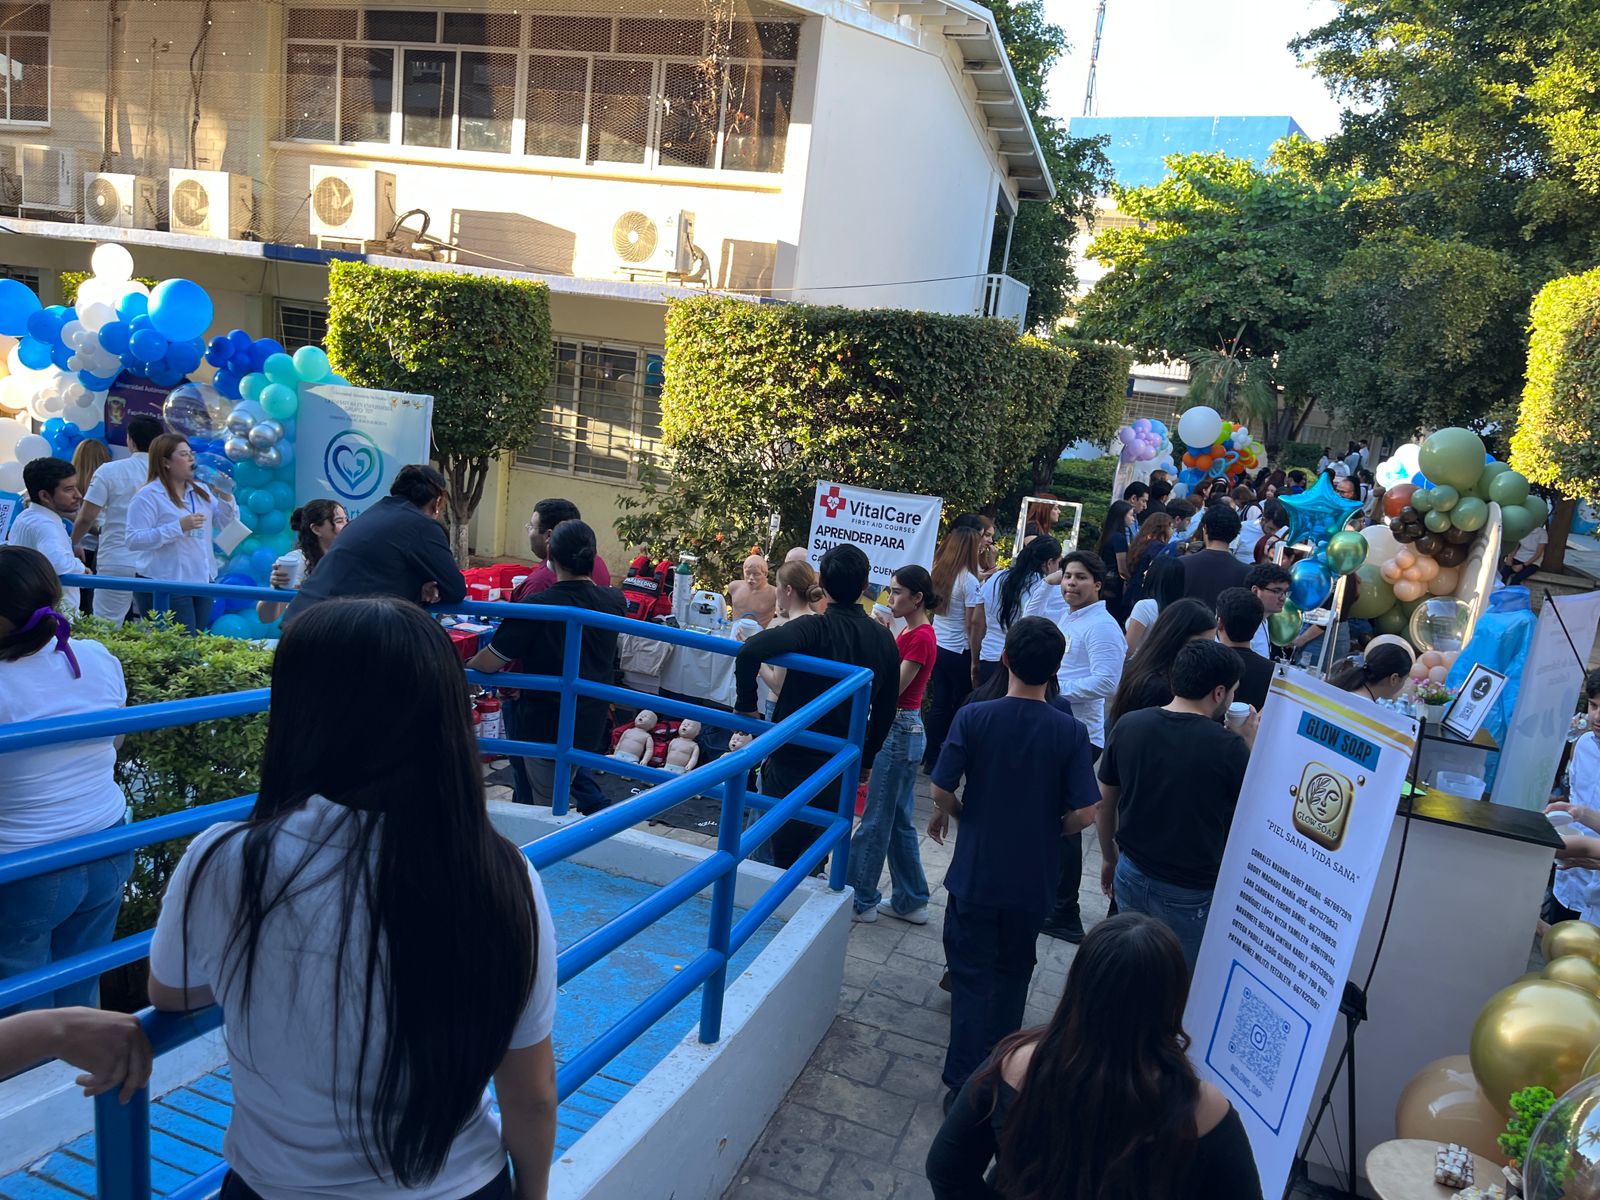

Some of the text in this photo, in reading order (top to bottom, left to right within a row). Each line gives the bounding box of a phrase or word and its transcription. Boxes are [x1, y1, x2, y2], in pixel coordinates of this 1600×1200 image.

[850, 500, 922, 526] VitalCare
[851, 518, 870, 527] FIRST
[885, 524, 916, 534] COURSES
[816, 524, 905, 550] APRENDER PARA
[1305, 717, 1373, 764] GLOW SOAP
[1296, 810, 1338, 840] GLOW SOAP
[1285, 833, 1310, 855] SANA,
[1311, 847, 1332, 868] VIDA
[1261, 871, 1282, 891] MACHADO
